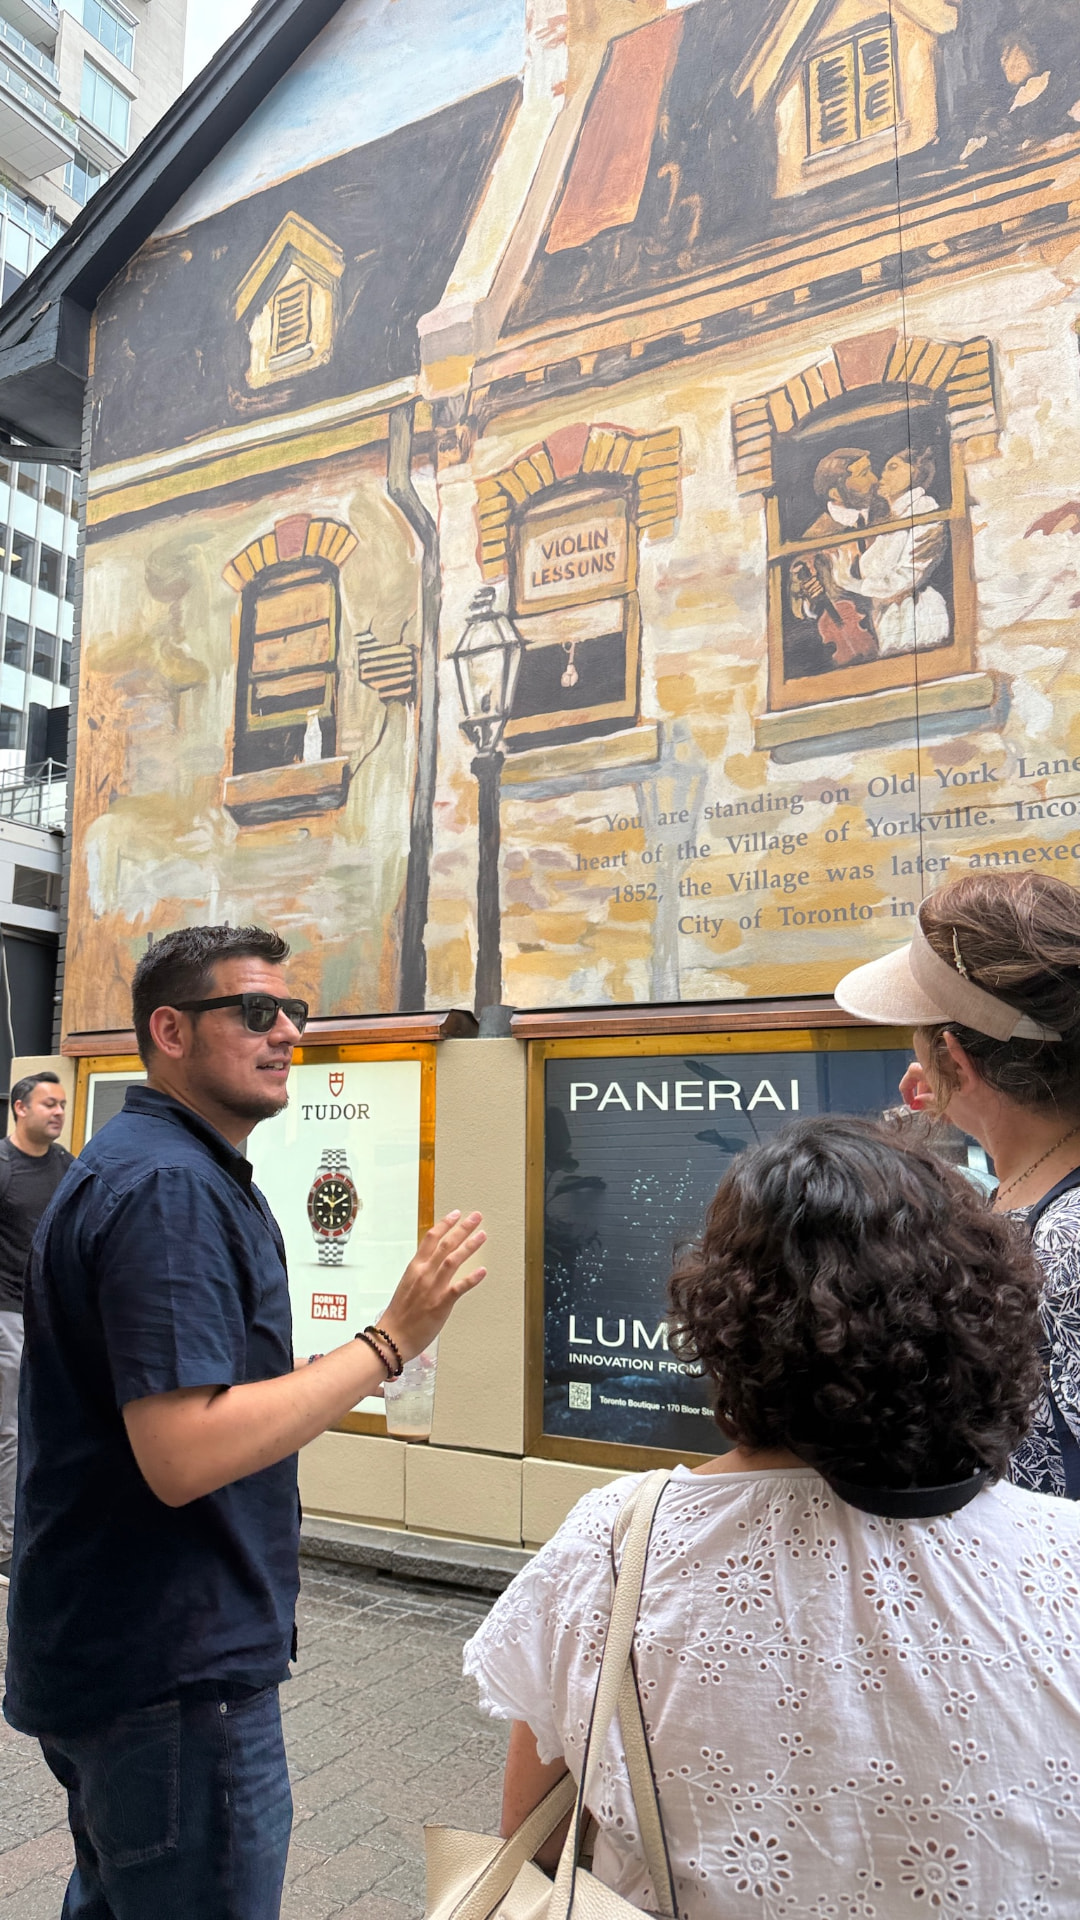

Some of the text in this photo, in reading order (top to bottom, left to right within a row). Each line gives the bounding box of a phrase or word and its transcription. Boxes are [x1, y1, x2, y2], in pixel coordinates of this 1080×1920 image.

[541, 527, 608, 560] VIOLIN
[605, 813, 643, 833] You
[657, 809, 690, 826] are
[704, 792, 805, 820] standing
[820, 786, 850, 804] on
[867, 772, 916, 798] Old
[934, 762, 999, 789] York
[576, 800, 1080, 872] heart of the Village of Yorkville. Inco
[612, 882, 664, 904] 1852,
[678, 877, 712, 898] the
[727, 869, 810, 894] Village
[825, 864, 875, 882] was
[892, 854, 951, 876] later
[678, 896, 916, 938] City of Toronto in
[302, 1103, 371, 1121] TUDOR
[569, 1079, 800, 1112] PANERAI
[313, 1304, 345, 1319] DARE
[314, 1295, 345, 1306] BORN TO
[569, 1353, 702, 1375] INNOVATION FROM
[600, 1395, 627, 1407] Toronto
[628, 1399, 660, 1411] Boutique
[667, 1404, 681, 1413] 170
[681, 1405, 701, 1415] Bloor
